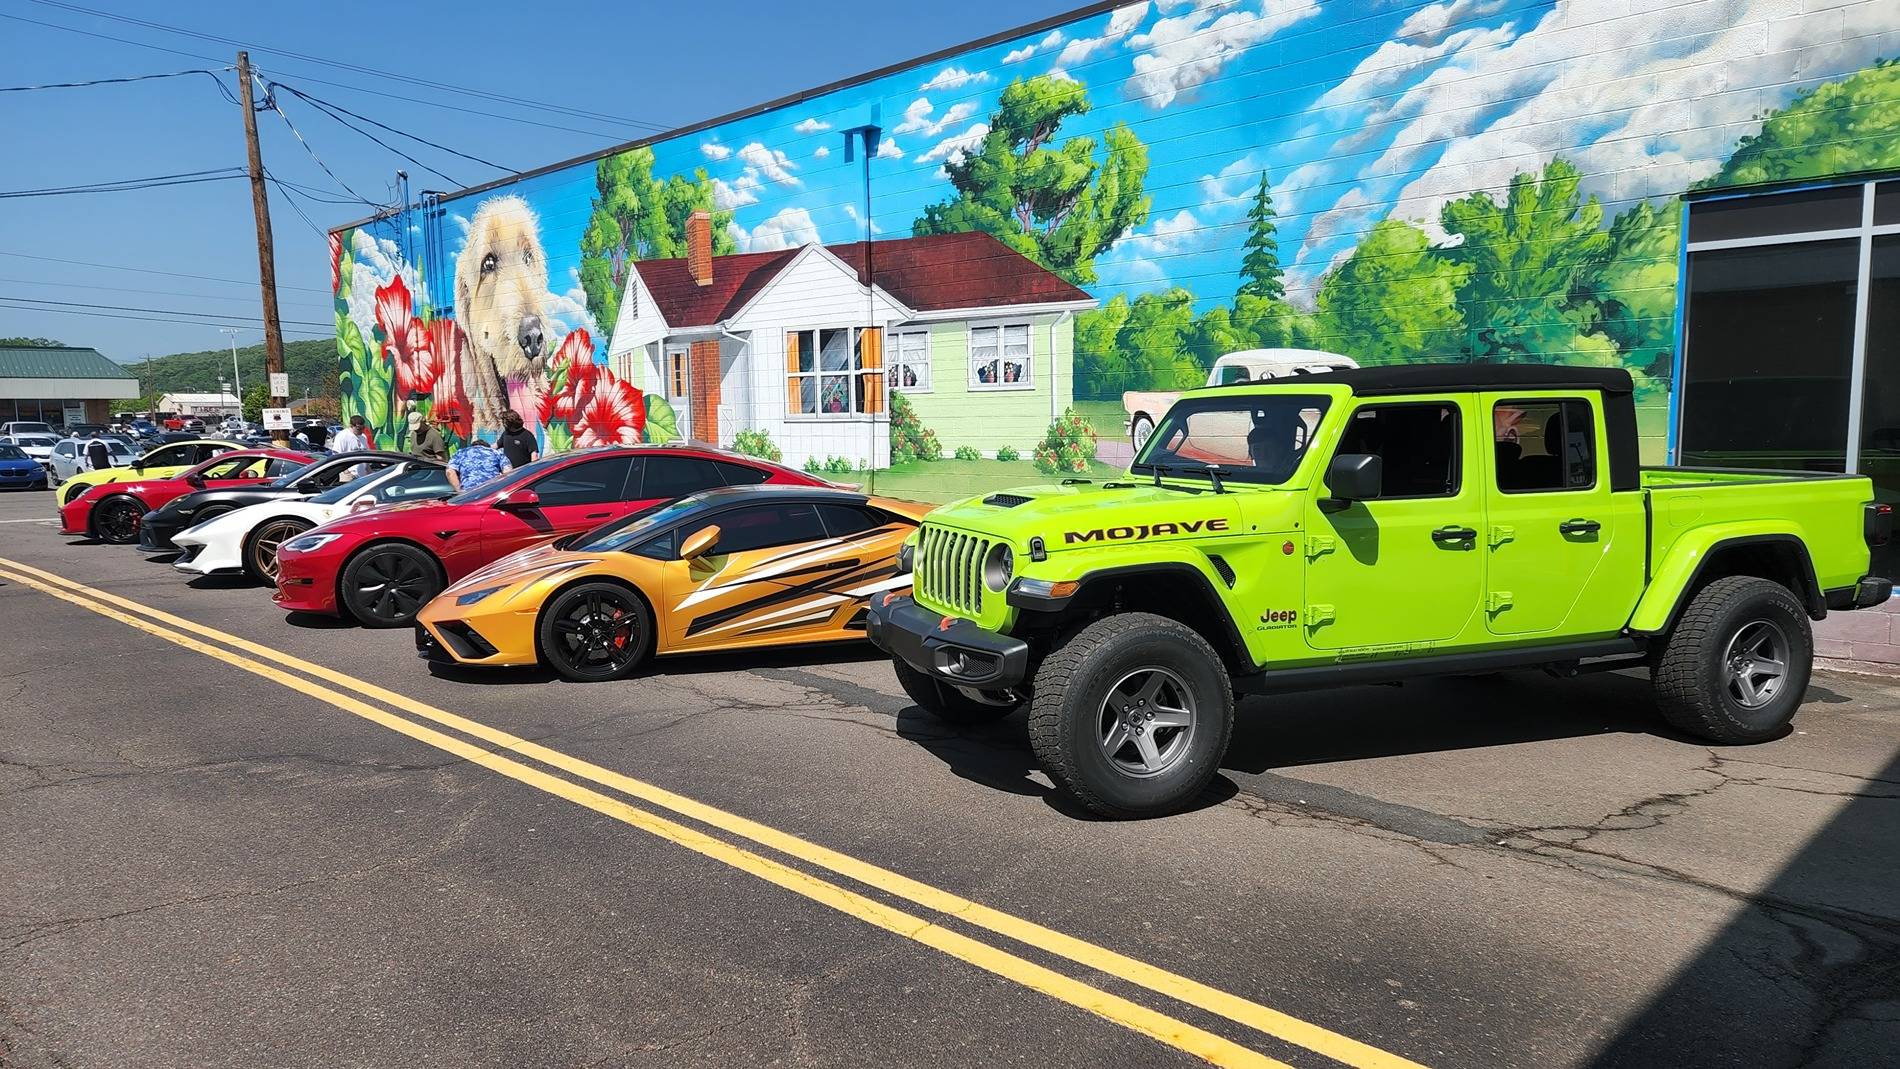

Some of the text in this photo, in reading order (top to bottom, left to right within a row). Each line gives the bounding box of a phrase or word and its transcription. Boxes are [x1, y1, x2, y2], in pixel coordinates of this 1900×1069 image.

[275, 386, 286, 394] 15
[1064, 518, 1230, 544] MOJAVE
[1260, 608, 1297, 624] Jeep
